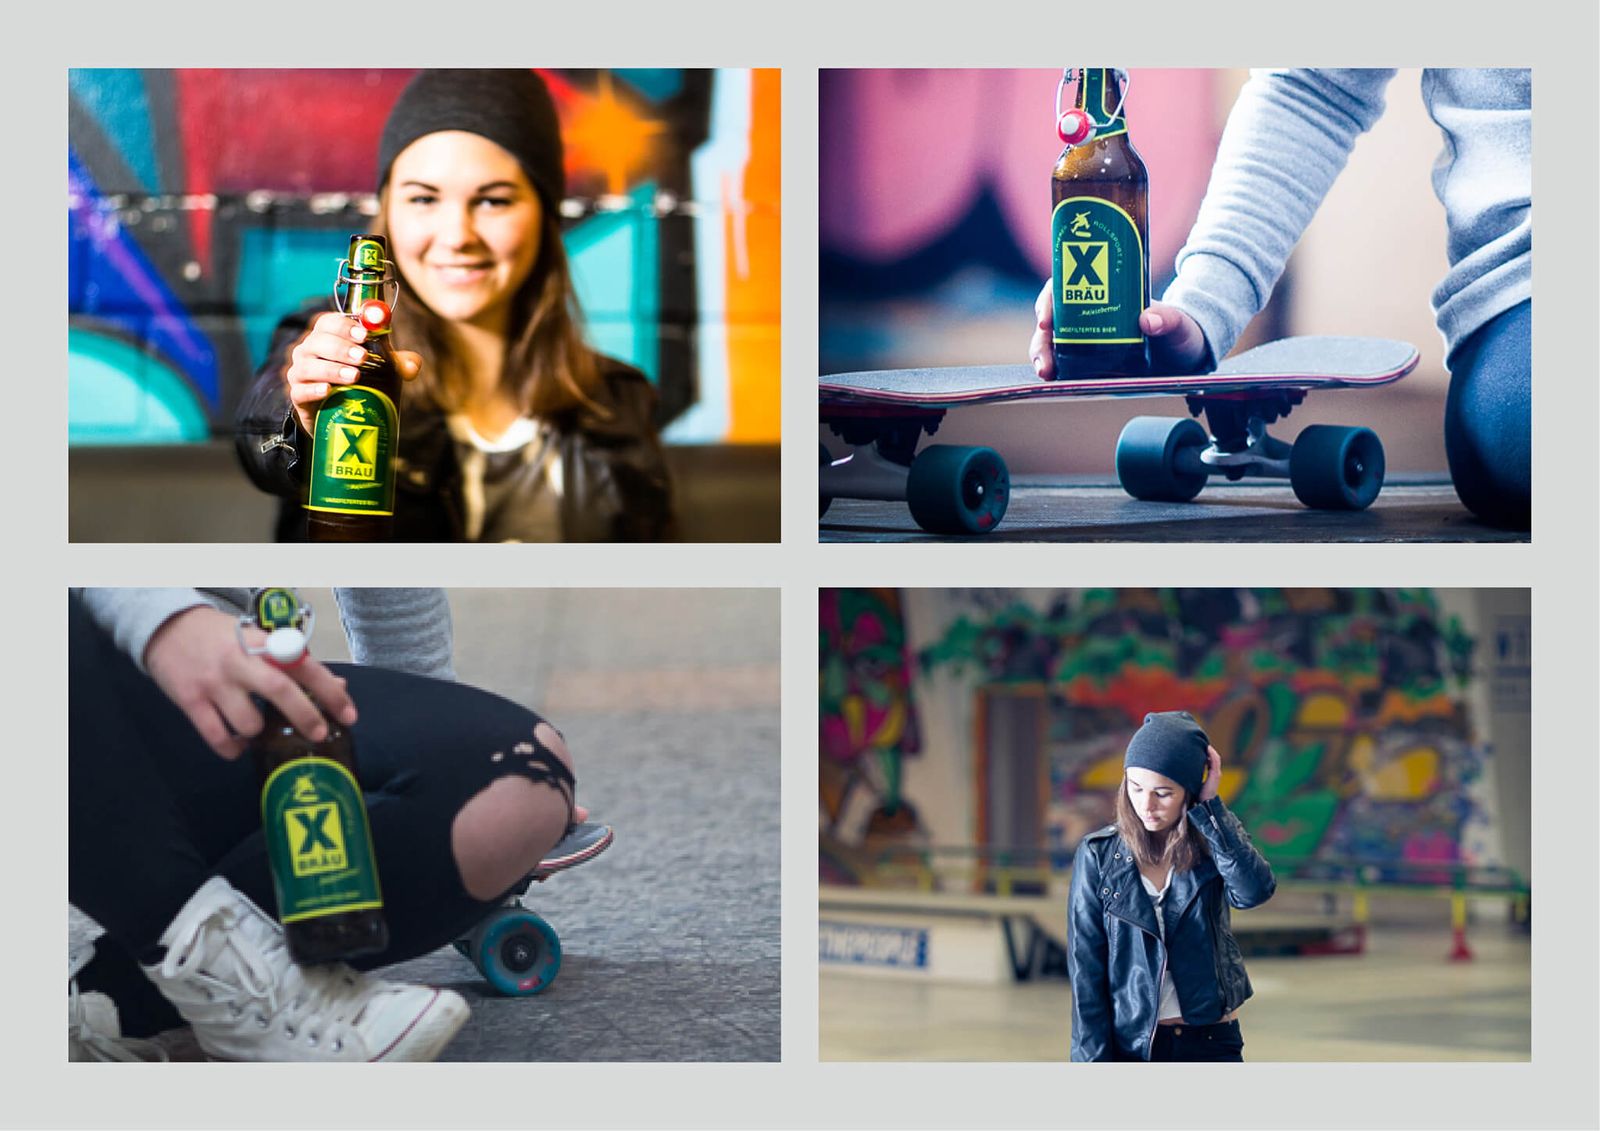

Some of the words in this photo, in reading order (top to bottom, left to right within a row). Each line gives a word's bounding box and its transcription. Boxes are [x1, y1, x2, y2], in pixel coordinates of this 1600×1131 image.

[1066, 245, 1105, 286] X
[1065, 286, 1105, 301] BRÄU
[338, 427, 375, 464] X
[295, 809, 337, 853] X
